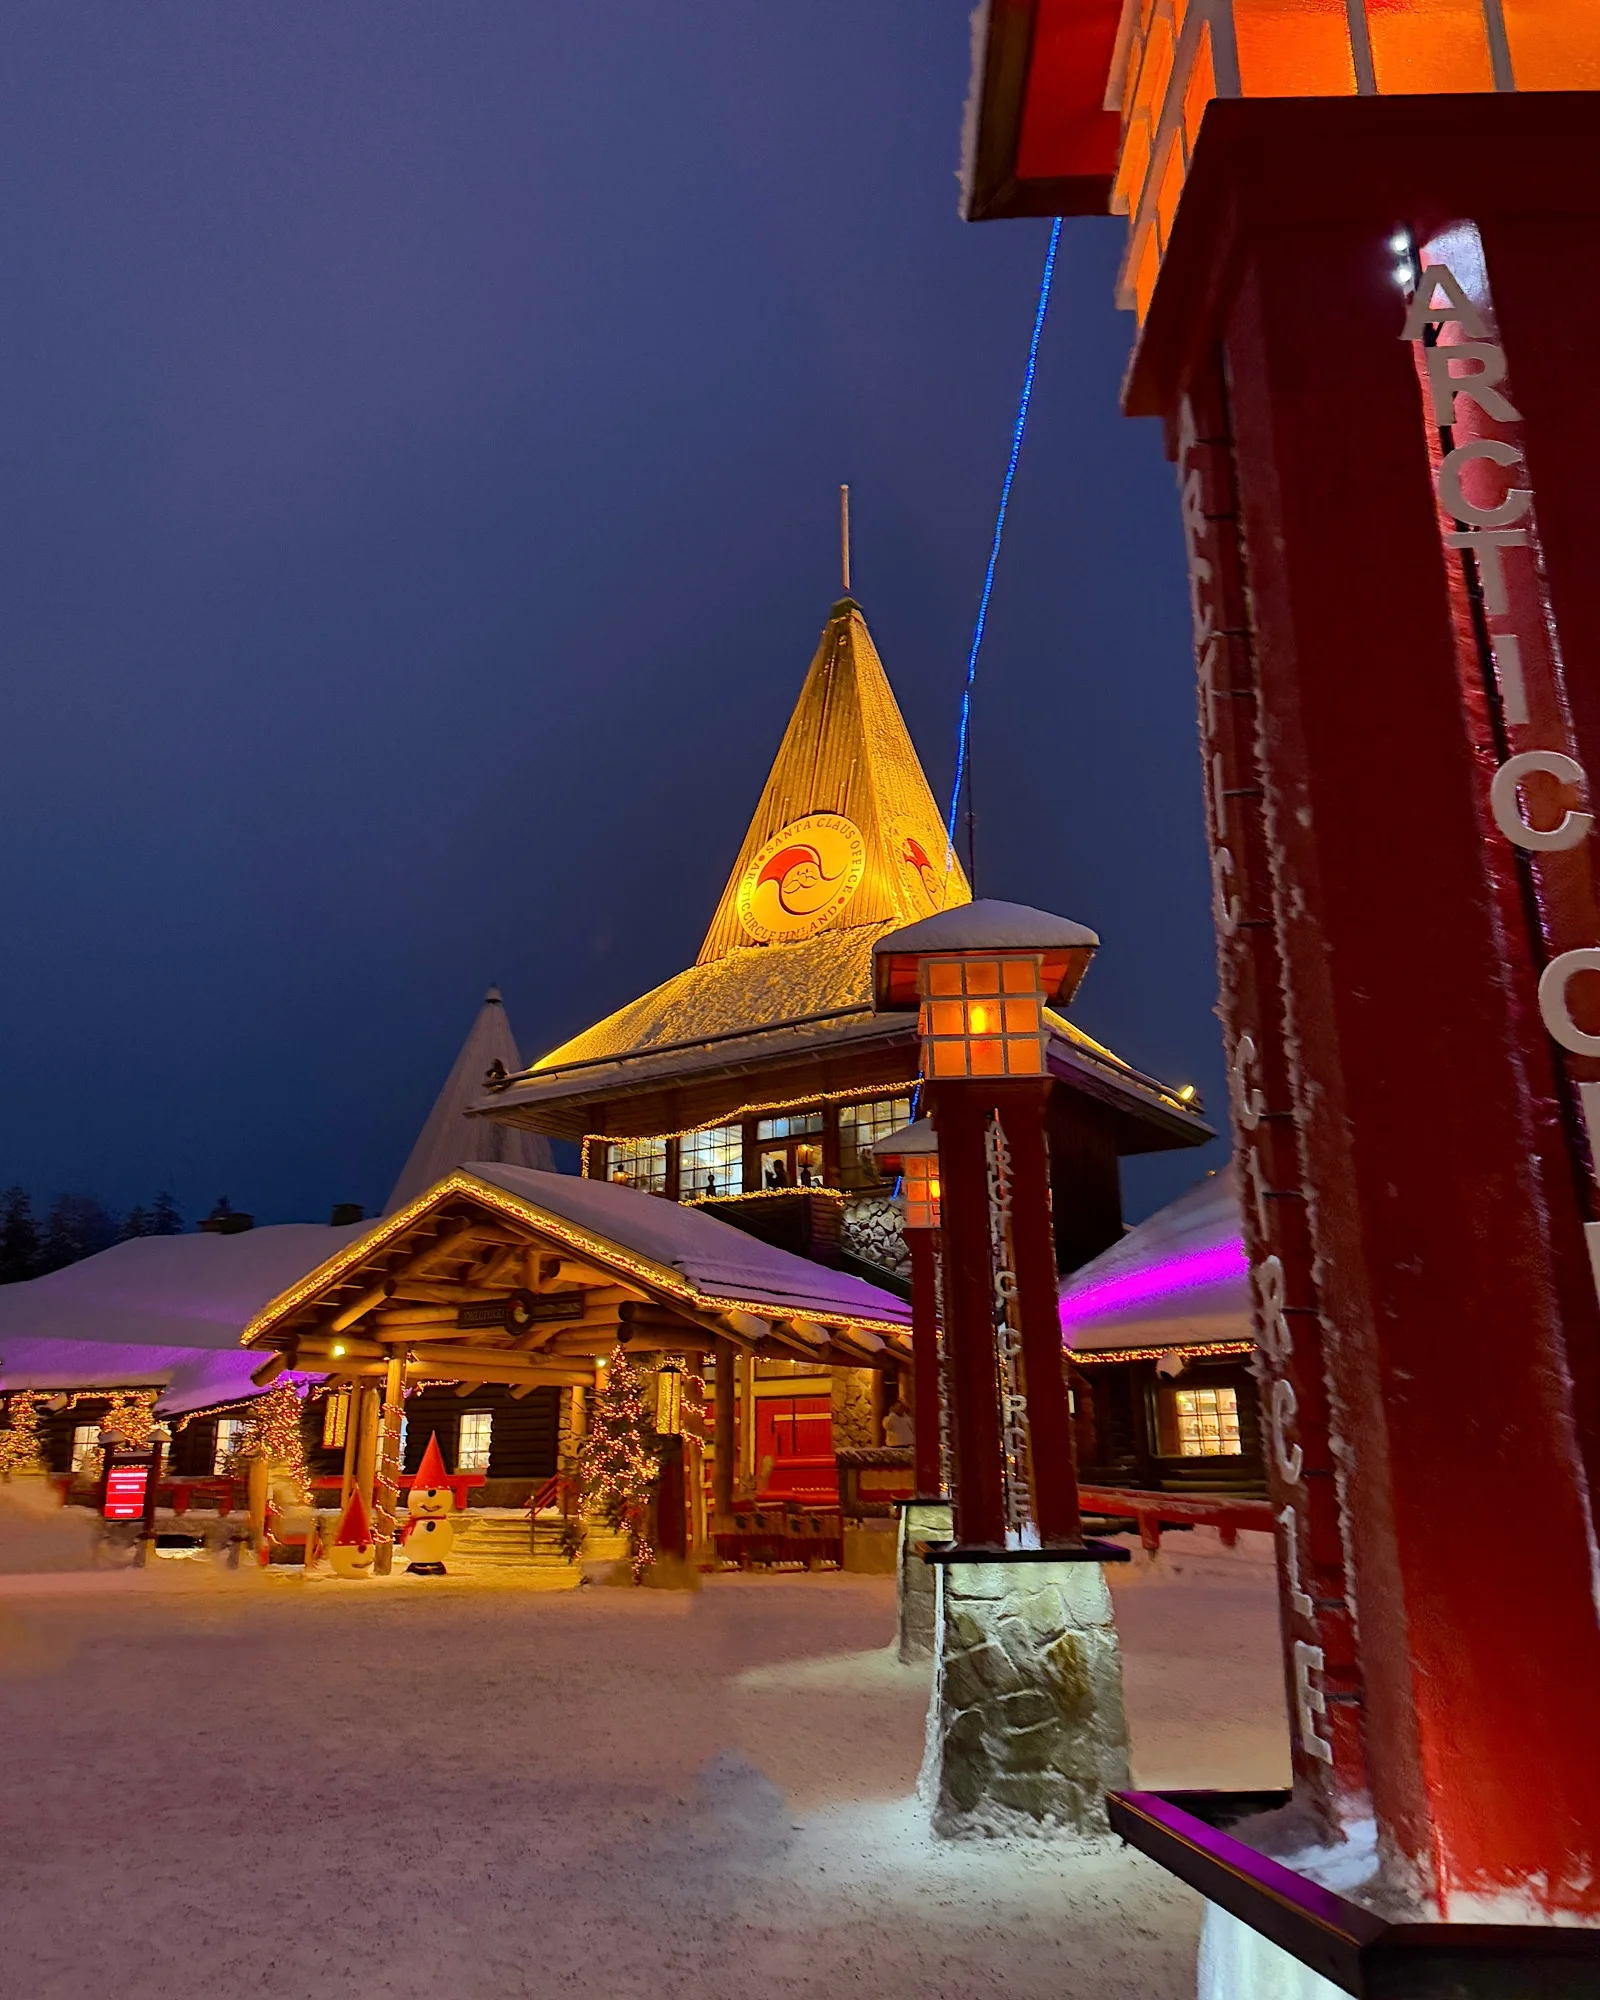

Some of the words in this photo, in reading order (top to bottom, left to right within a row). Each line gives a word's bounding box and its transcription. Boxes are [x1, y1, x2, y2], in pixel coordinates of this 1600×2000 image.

[1399, 264, 1595, 851] ARCTIC
[741, 862, 760, 912] ARCTIC
[766, 820, 811, 854] SANTA
[816, 817, 855, 840] CLAUS
[842, 840, 862, 894] OFFICE
[743, 911, 777, 941] CIRCLE
[778, 905, 837, 939] FINLAND
[986, 1120, 1019, 1298] ARCTIC
[998, 1327, 1031, 1525] CIRCLE
[1232, 1036, 1334, 1765] CIRCLE
